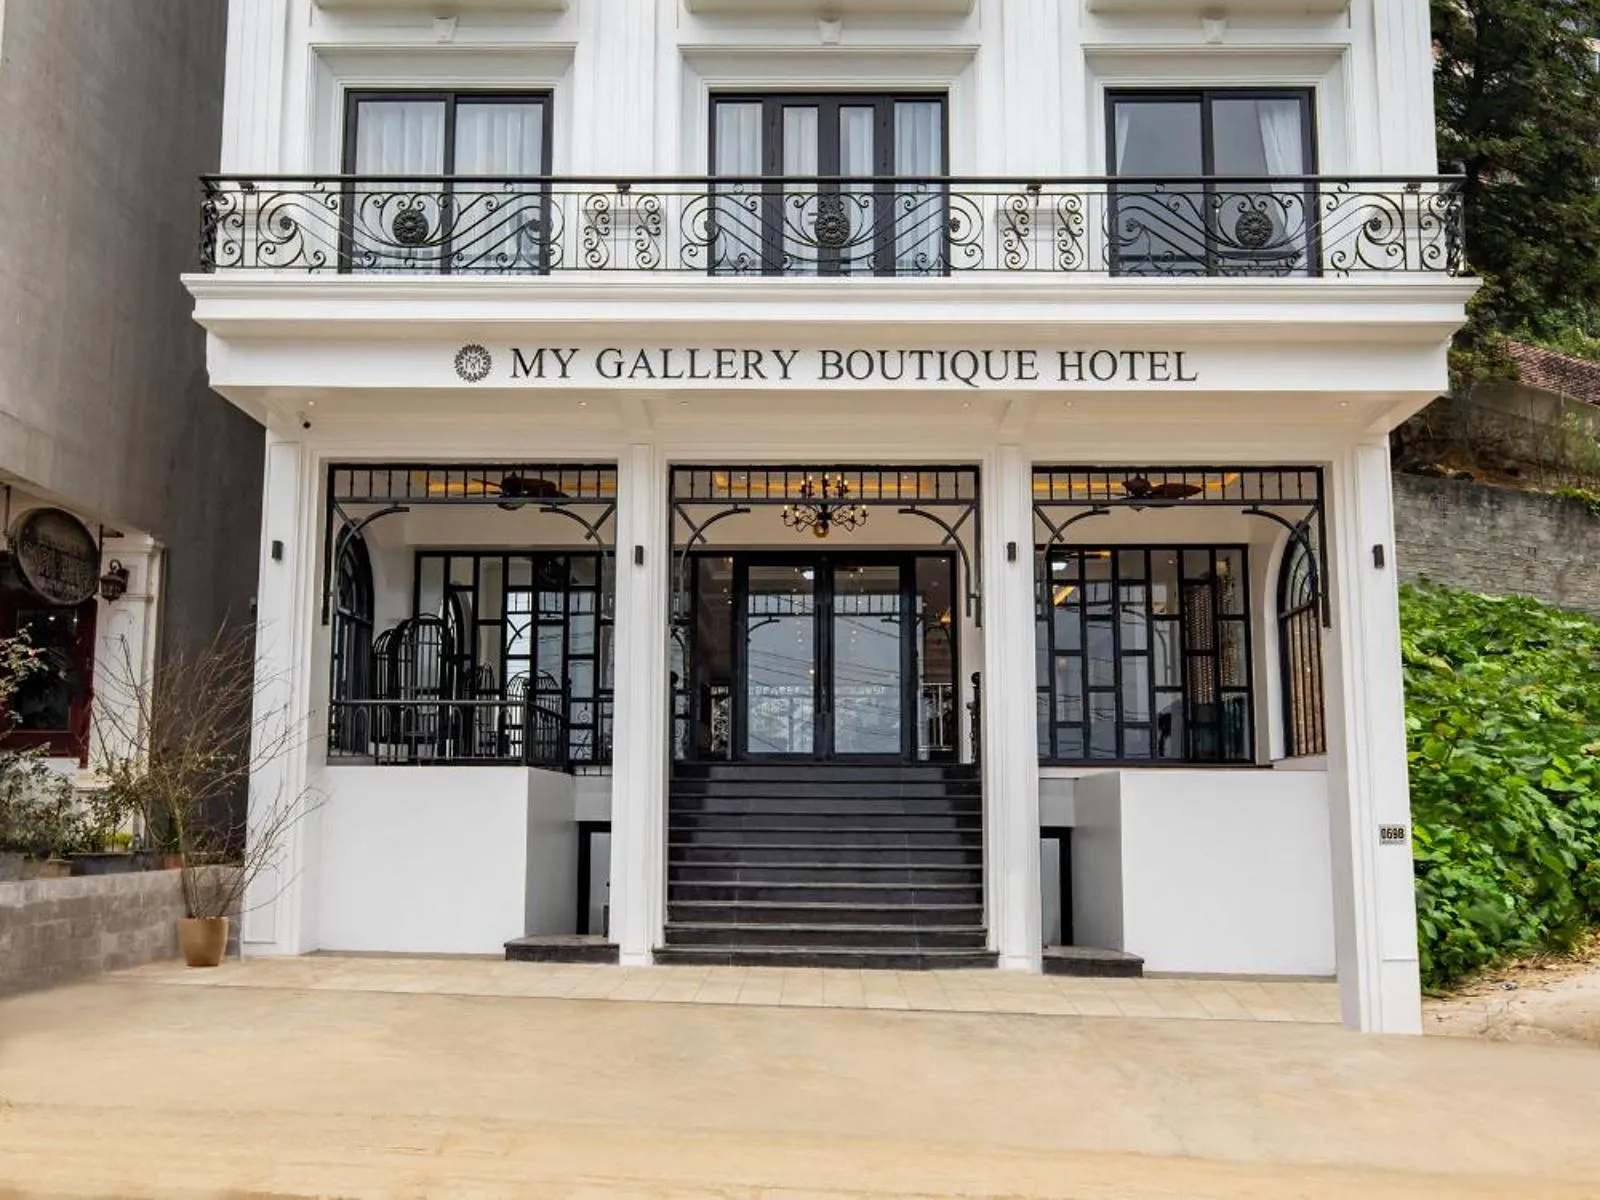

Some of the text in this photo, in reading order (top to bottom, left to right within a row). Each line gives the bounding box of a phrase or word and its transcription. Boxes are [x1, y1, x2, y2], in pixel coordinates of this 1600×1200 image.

[510, 347, 1199, 388] MY GALLERY BOUTIQUE HOTEL
